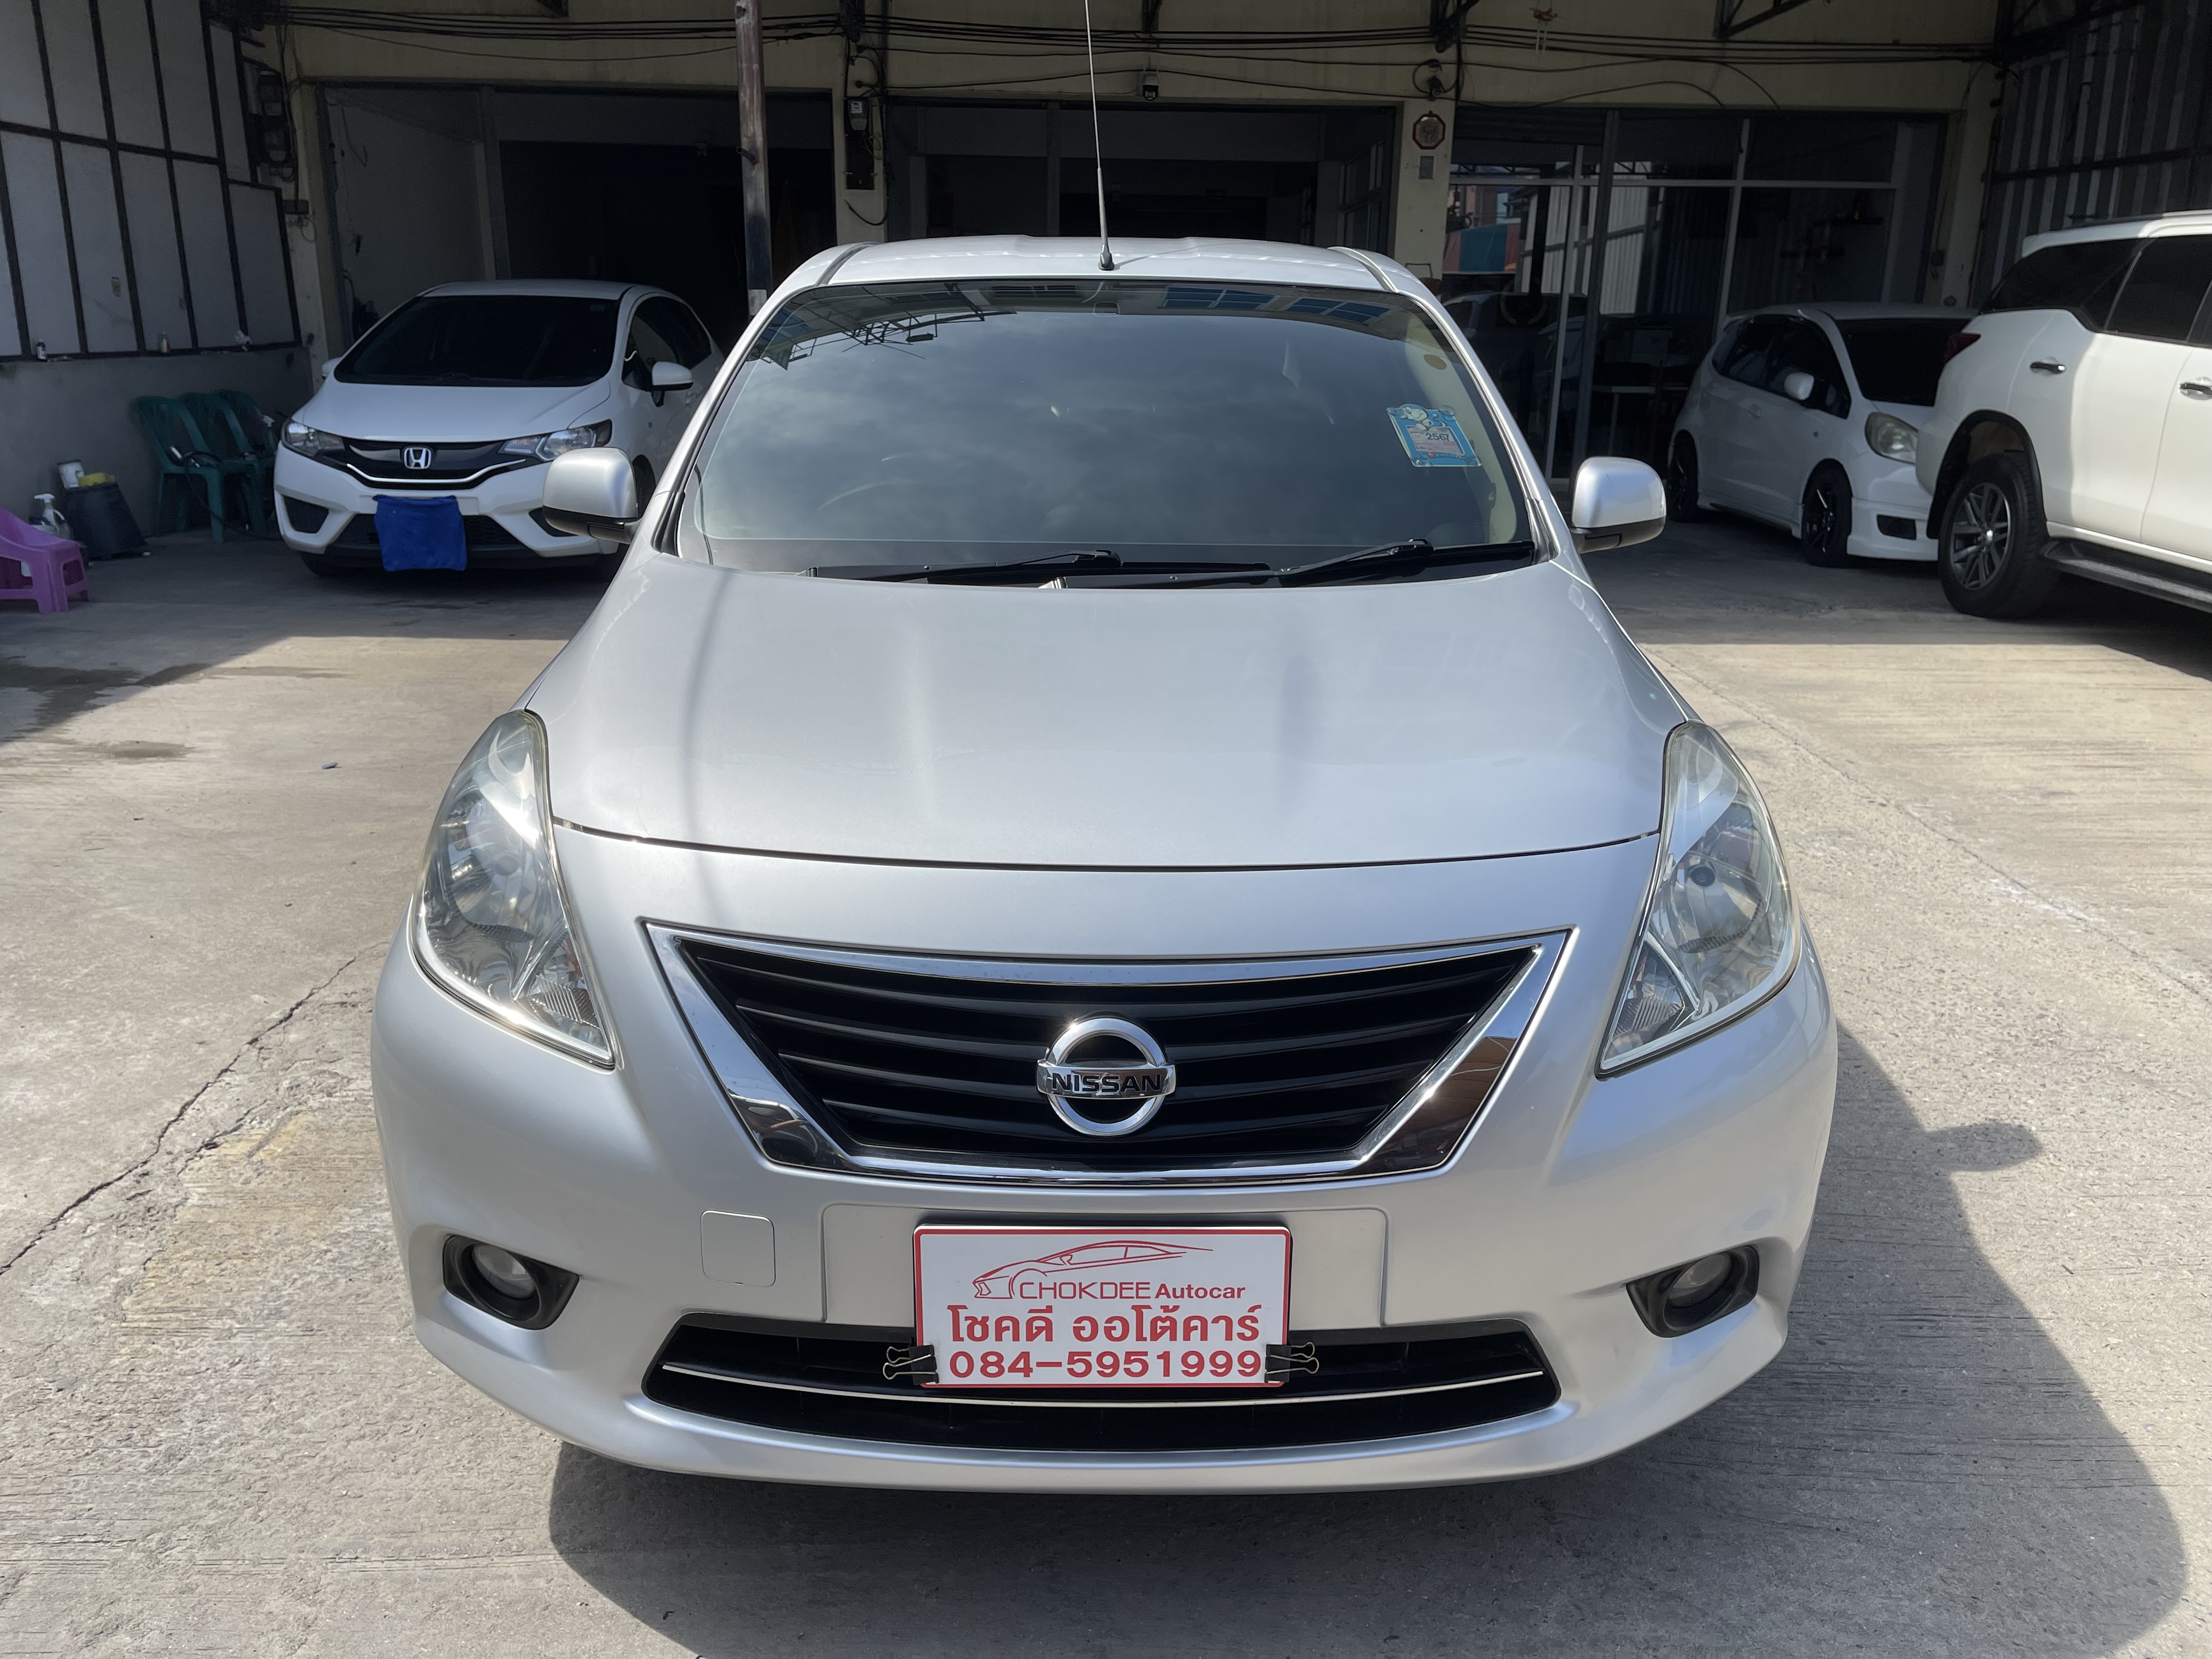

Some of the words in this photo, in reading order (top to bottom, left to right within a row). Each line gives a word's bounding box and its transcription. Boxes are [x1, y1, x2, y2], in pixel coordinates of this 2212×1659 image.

[1426, 432, 1449, 441] 2567
[1052, 1073, 1161, 1093] NISSAN
[1019, 1282, 1151, 1300] CHOKDEE
[1155, 1283, 1246, 1299] Autocar
[947, 1305, 1053, 1342] โชคดี
[1073, 1305, 1262, 1342] ออโต้คาร์
[949, 1350, 1262, 1378] 084-5951999
